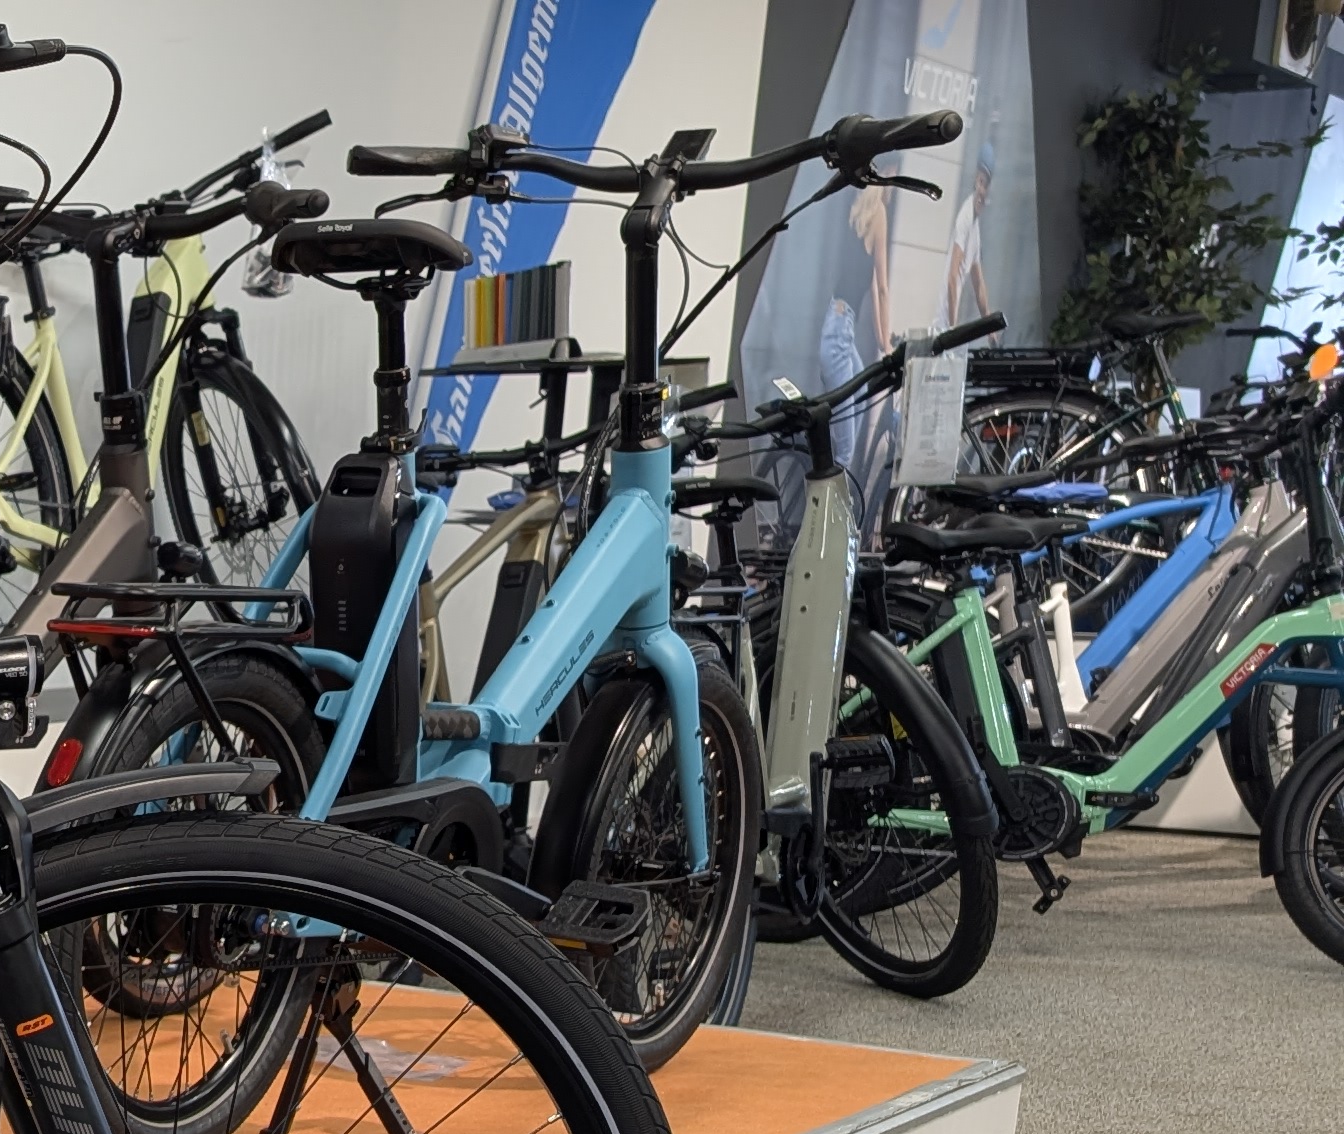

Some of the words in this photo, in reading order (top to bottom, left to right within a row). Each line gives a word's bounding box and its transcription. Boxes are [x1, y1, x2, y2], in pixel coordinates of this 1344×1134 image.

[498, 0, 560, 138] Allgem
[904, 58, 978, 112] VICTORIA
[534, 629, 595, 718] HERCULES
[1224, 646, 1268, 689] VICTORIA
[21, 1017, 47, 1032] RST
